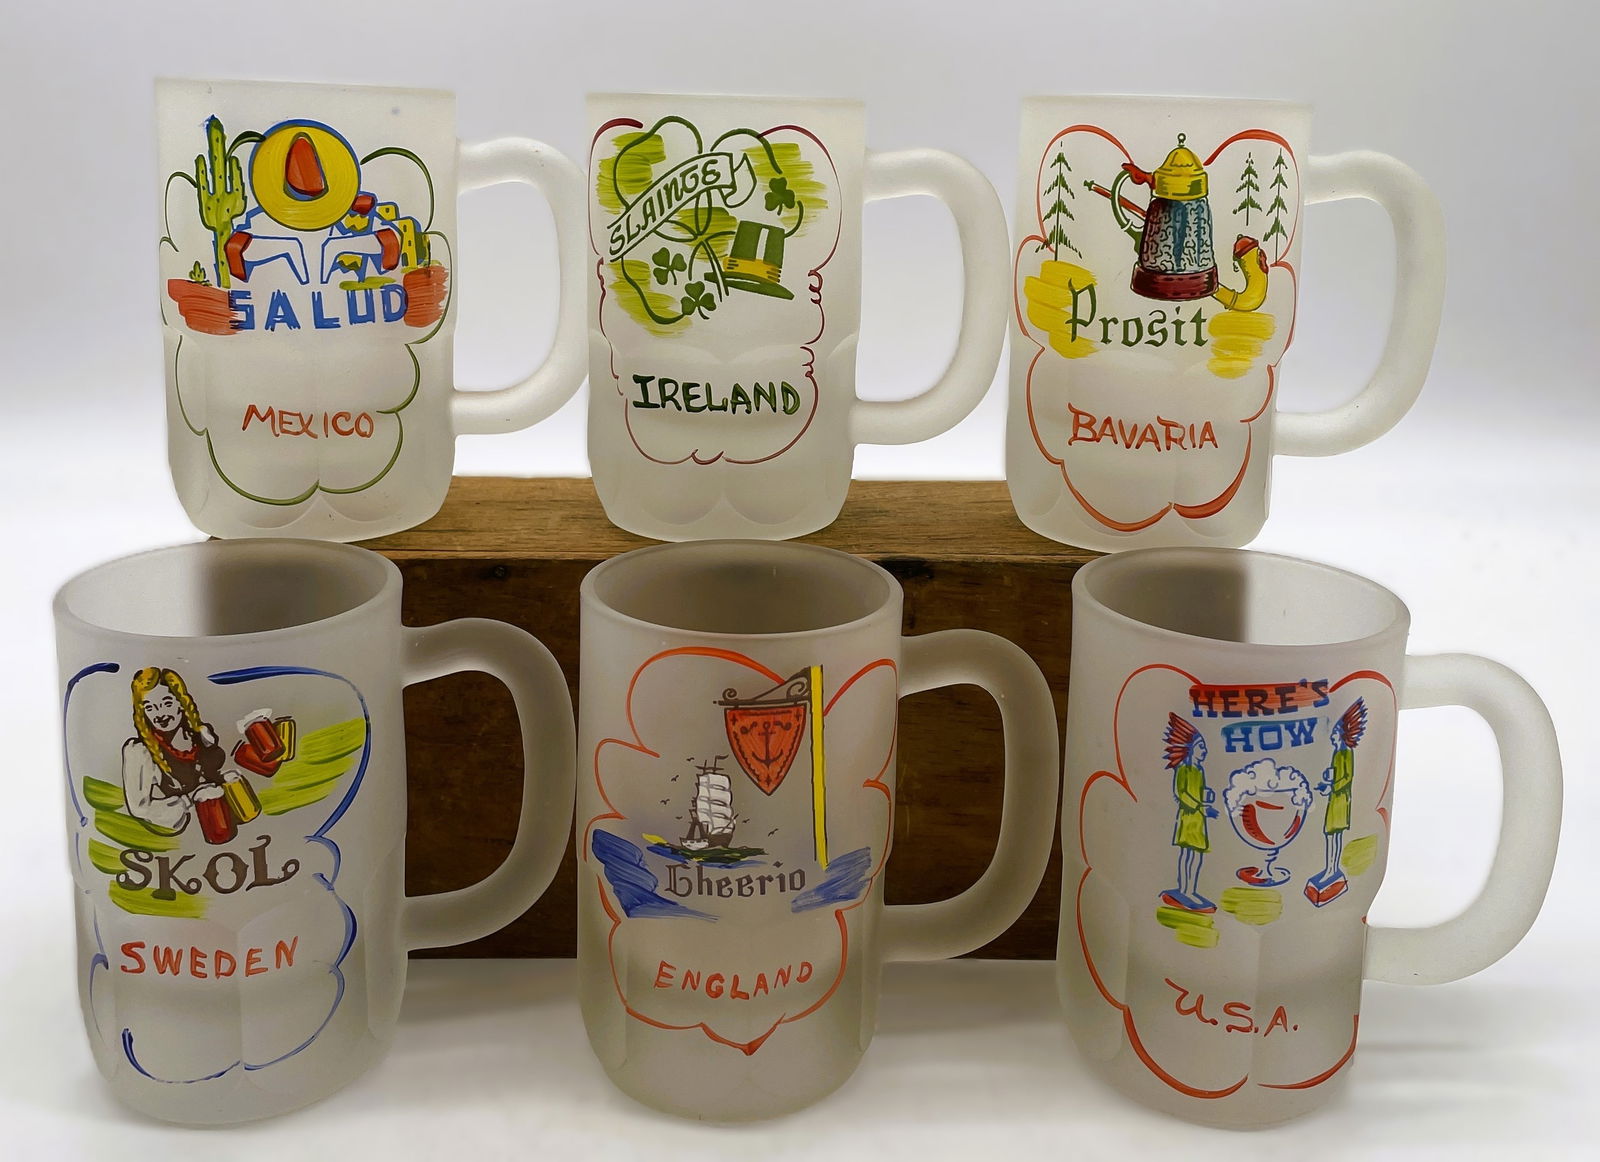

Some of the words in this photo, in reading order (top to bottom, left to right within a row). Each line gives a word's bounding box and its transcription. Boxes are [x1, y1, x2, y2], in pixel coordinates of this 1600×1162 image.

[228, 284, 408, 331] SALUD
[1064, 278, 1209, 347] Prosit
[632, 374, 801, 415] IRELAND
[242, 404, 374, 439] MEXICO
[1067, 402, 1218, 452] BAVARIA
[1192, 678, 1330, 718] HERE'S
[1225, 717, 1318, 753] HOW
[116, 834, 300, 900] SKOL
[664, 860, 807, 898] Cheerio
[120, 936, 299, 979] SWEDEN
[654, 960, 813, 1000] ENGLAND
[1164, 977, 1299, 1037] U.S.A.
